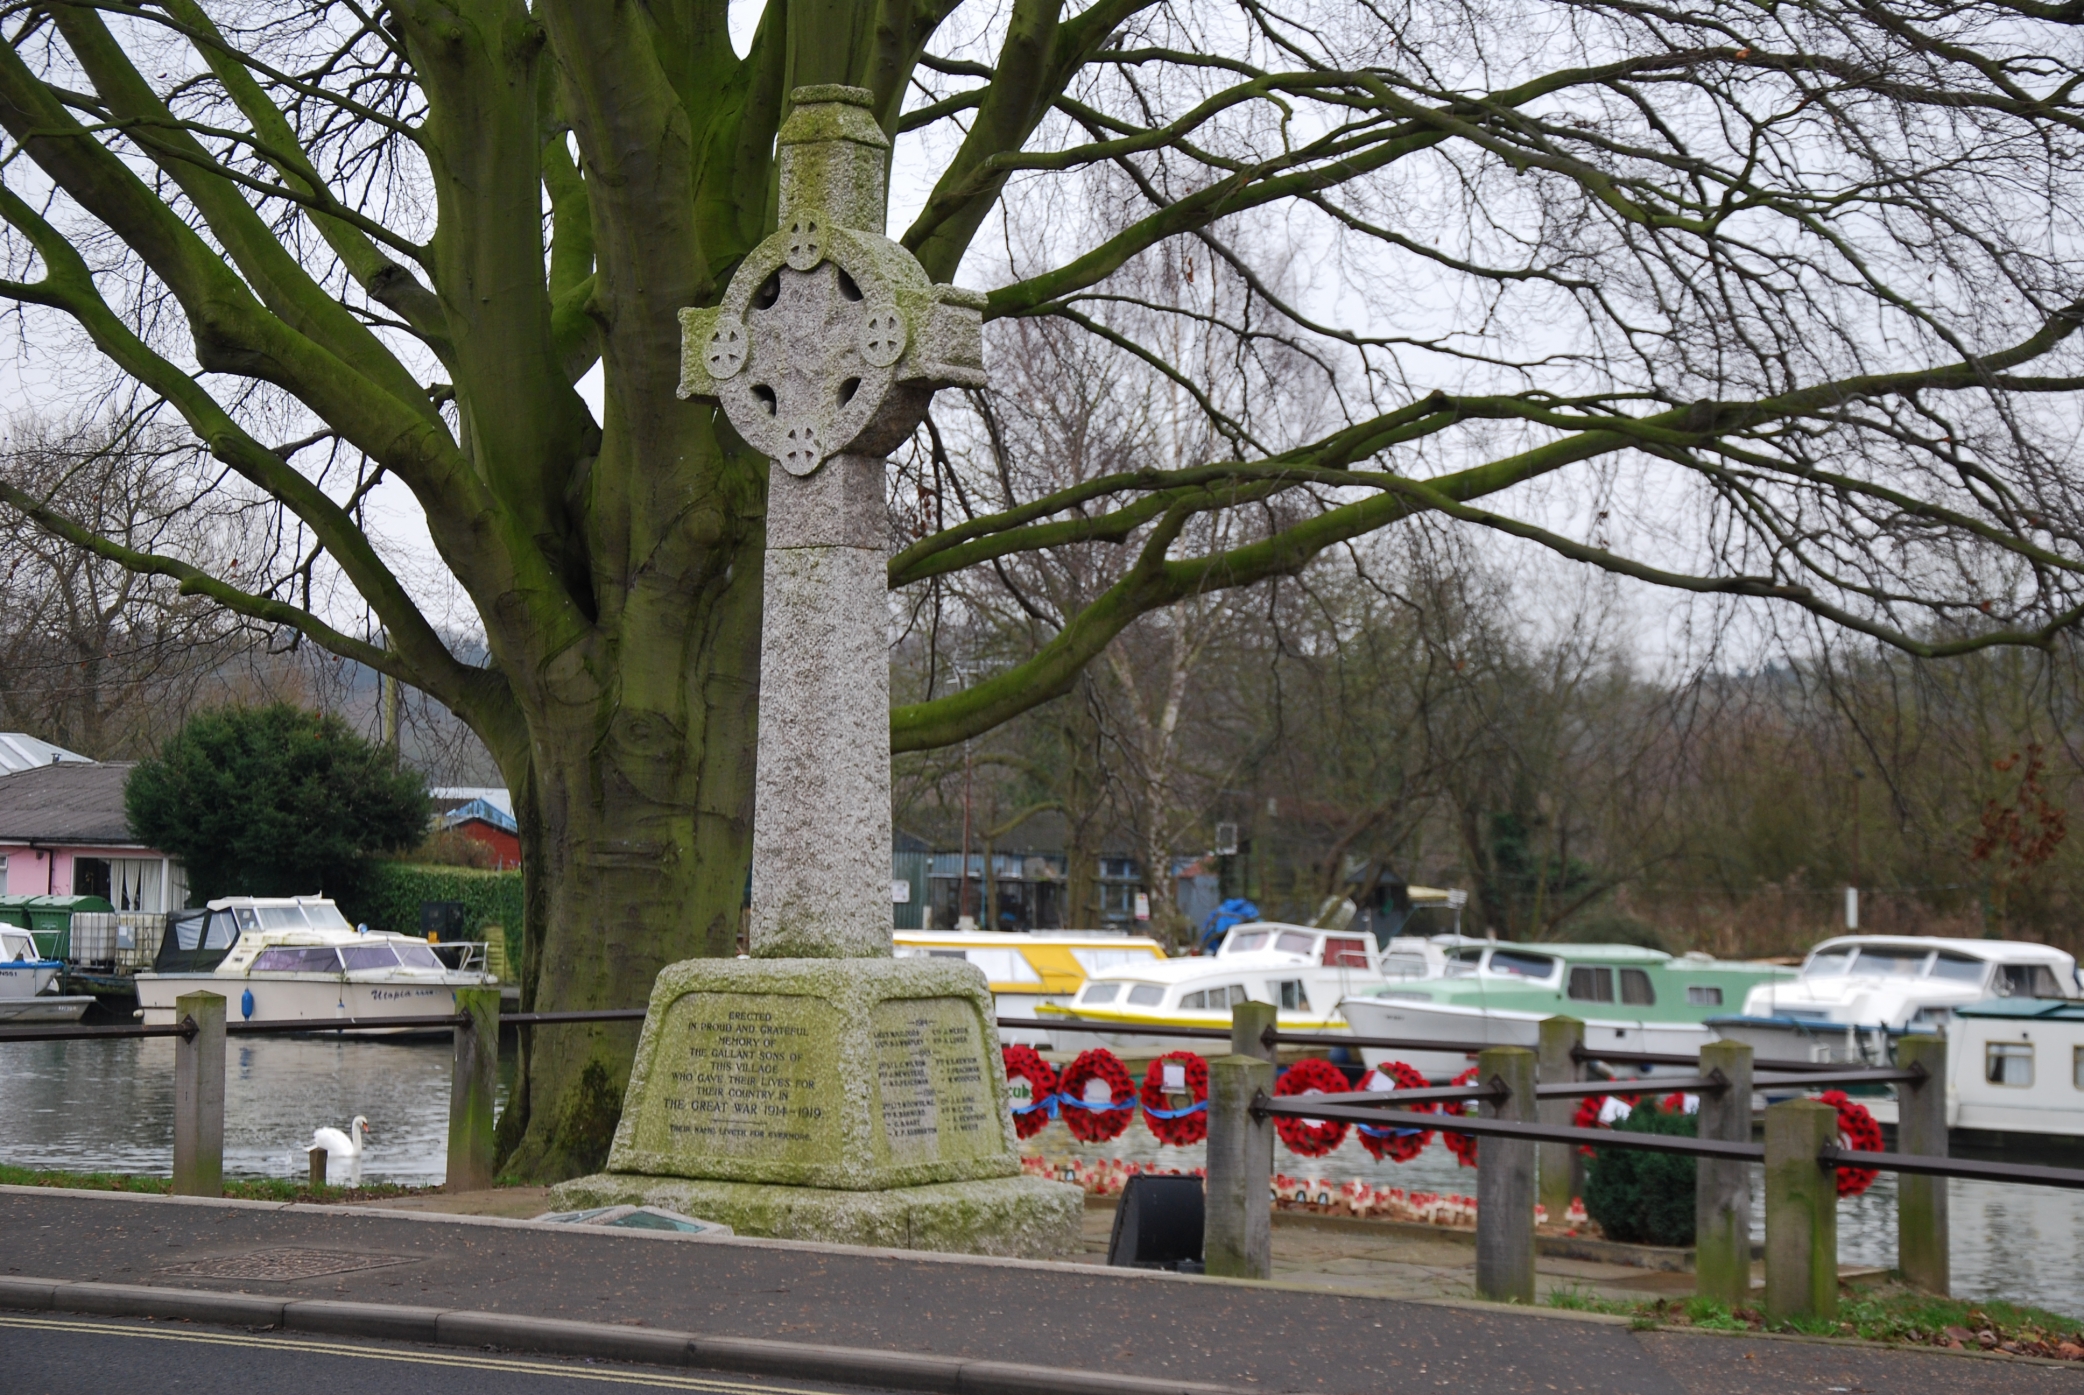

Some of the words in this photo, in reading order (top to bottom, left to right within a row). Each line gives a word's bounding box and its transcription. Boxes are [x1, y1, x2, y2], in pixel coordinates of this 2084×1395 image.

[371, 988, 412, 1001] Utopia
[728, 1011, 772, 1021] ERECTED
[688, 1022, 697, 1031] IN
[701, 1022, 732, 1032] PROUD
[736, 1024, 755, 1034] AND
[760, 1025, 809, 1036] GRATEFUL
[718, 1036, 760, 1047] MEMORY
[763, 1038, 777, 1048] OF
[689, 1047, 708, 1057] THE
[711, 1049, 756, 1060] GALLANT
[759, 1052, 785, 1061] SONS
[789, 1053, 803, 1062] OF
[711, 1062, 732, 1072] THIS
[735, 1063, 778, 1073] VILLAGE
[671, 1072, 693, 1082] WHO
[697, 1073, 723, 1083] GAVE
[728, 1075, 756, 1086] THEIR
[761, 1077, 790, 1088] LIVES
[795, 1079, 816, 1089] FOR
[696, 1086, 724, 1096] THEIR
[728, 1088, 775, 1100] COUNTRY
[778, 1090, 789, 1100] IN
[663, 1098, 685, 1109] THE
[691, 1099, 728, 1113] GREAT
[734, 1102, 757, 1115] WAR
[670, 1124, 690, 1133] THEIR
[719, 1127, 747, 1137] LIVETH
[750, 1130, 764, 1138] FOR
